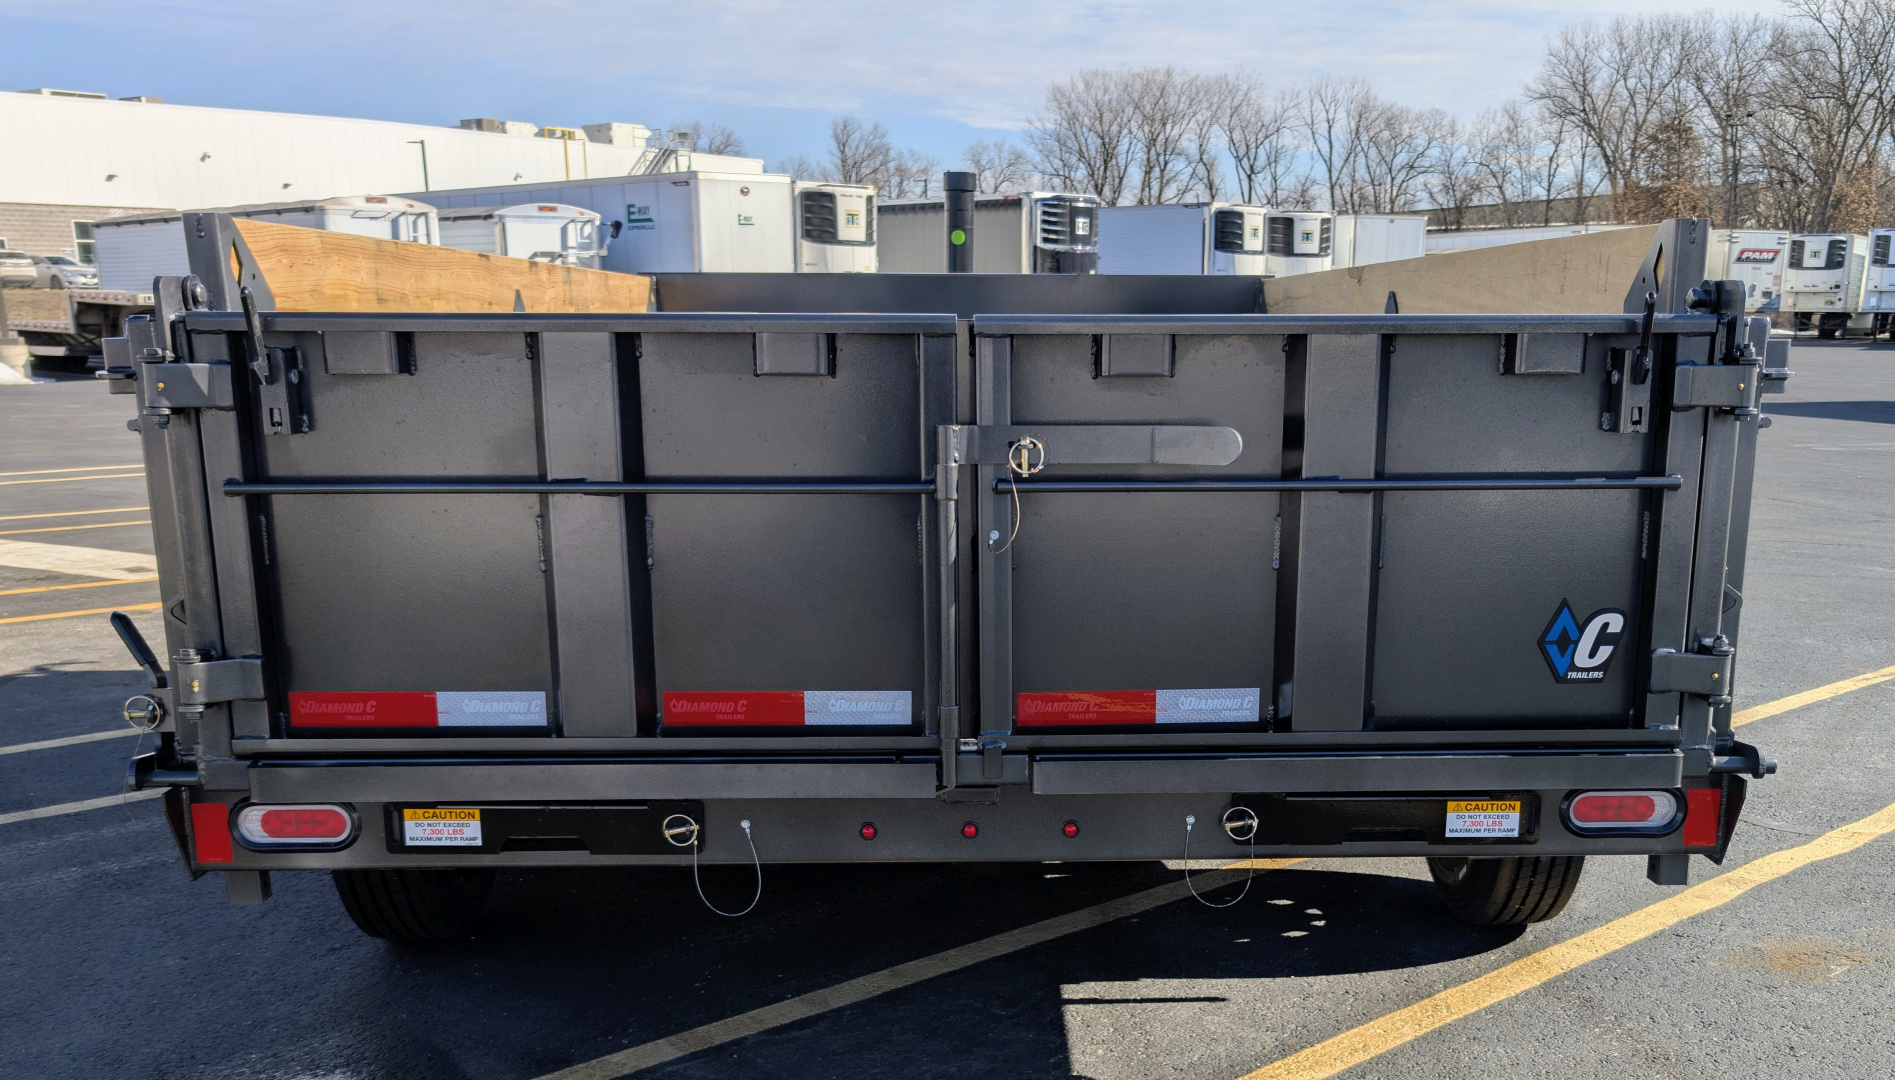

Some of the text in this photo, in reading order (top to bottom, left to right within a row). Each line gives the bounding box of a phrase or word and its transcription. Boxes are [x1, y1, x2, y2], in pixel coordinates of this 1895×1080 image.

[1741, 252, 1774, 260] PAM
[1567, 671, 1604, 679] TRAILERS
[305, 701, 377, 713] DIAMOND C
[471, 700, 529, 712] DIAMOND
[677, 700, 748, 712] DIAMOND C
[835, 701, 892, 712] DIAMOND
[1031, 700, 1100, 712] DIAMOND C
[1186, 696, 1254, 710] DIAMOND C
[1465, 803, 1516, 811] CAUTION
[422, 811, 475, 819] CAUTION
